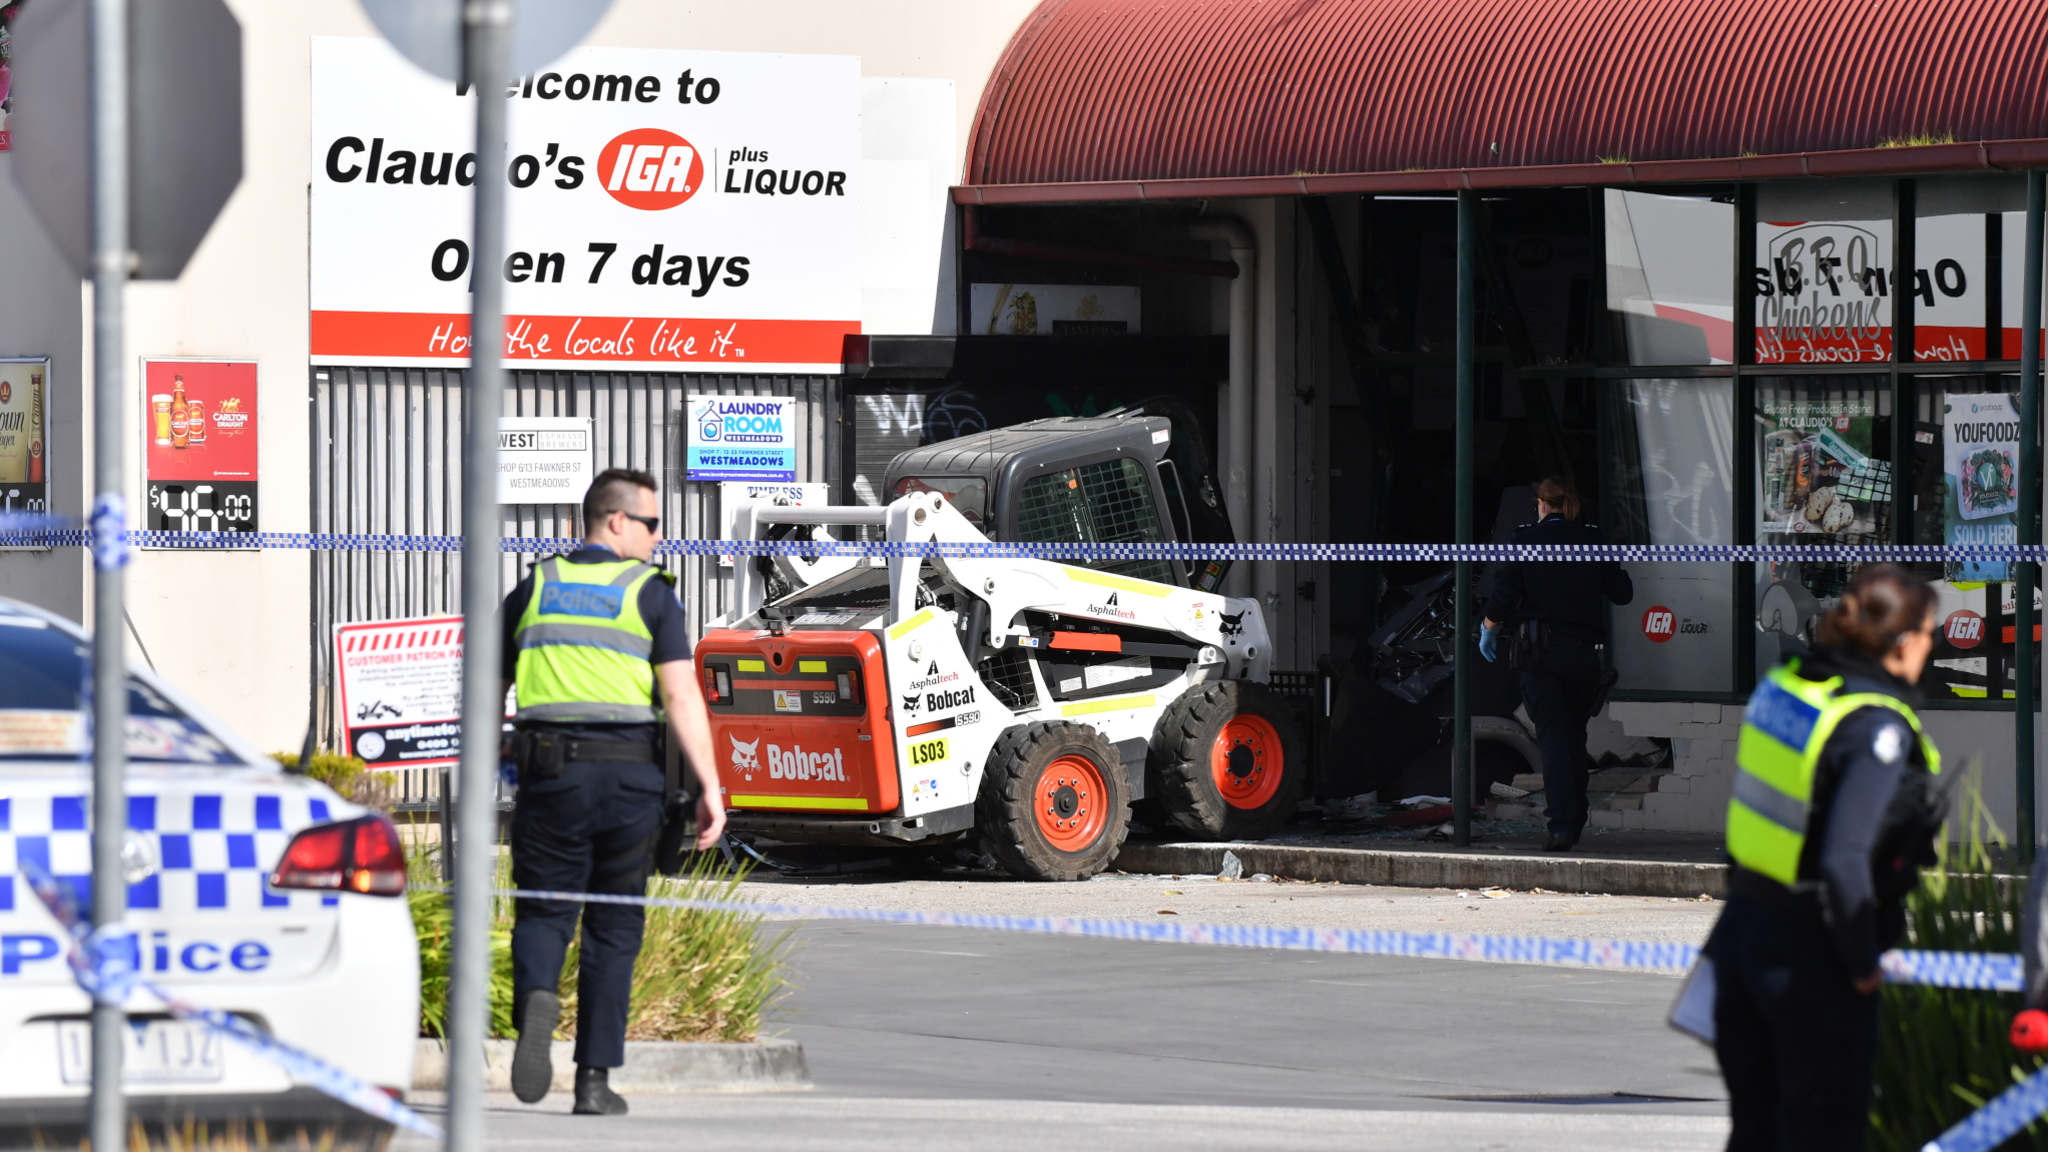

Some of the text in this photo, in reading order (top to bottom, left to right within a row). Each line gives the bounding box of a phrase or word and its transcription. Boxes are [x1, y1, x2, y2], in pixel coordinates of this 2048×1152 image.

[456, 68, 720, 104] lcome to
[325, 135, 694, 193] Clauo's IGA
[729, 147, 768, 165] plus
[724, 169, 846, 196] LIQUOR
[431, 239, 750, 297] Oen 7 days
[1762, 290, 1882, 342] Chickens
[429, 322, 473, 352] Ho
[507, 319, 552, 358] the
[565, 317, 634, 356] locals
[651, 320, 698, 358] like
[710, 322, 737, 358] it
[213, 412, 248, 421] CARLTON
[719, 402, 782, 415] LAUNDRY
[724, 416, 782, 433] ROOM
[1954, 421, 2020, 443] YOUFOODZ
[498, 433, 535, 448] WEST
[534, 463, 571, 472] FAWKNER
[572, 463, 582, 472] ST
[700, 456, 784, 466] WESTMEADOWS
[510, 478, 570, 488] WESTMEADOWS
[1955, 524, 1985, 545] SOLD
[543, 586, 619, 612] Police
[1086, 603, 1136, 620] Asphaltech
[1645, 611, 1672, 634] IGA
[1949, 616, 1981, 641] IGA
[347, 653, 403, 666] CUSTOMER
[406, 651, 446, 663] PATRON
[909, 671, 959, 690] Asphaltech
[926, 685, 976, 712] Bobcat
[956, 710, 981, 727] S590
[767, 743, 845, 782] Bobcat
[912, 741, 945, 765] LS03
[0, 932, 271, 974] Pice
